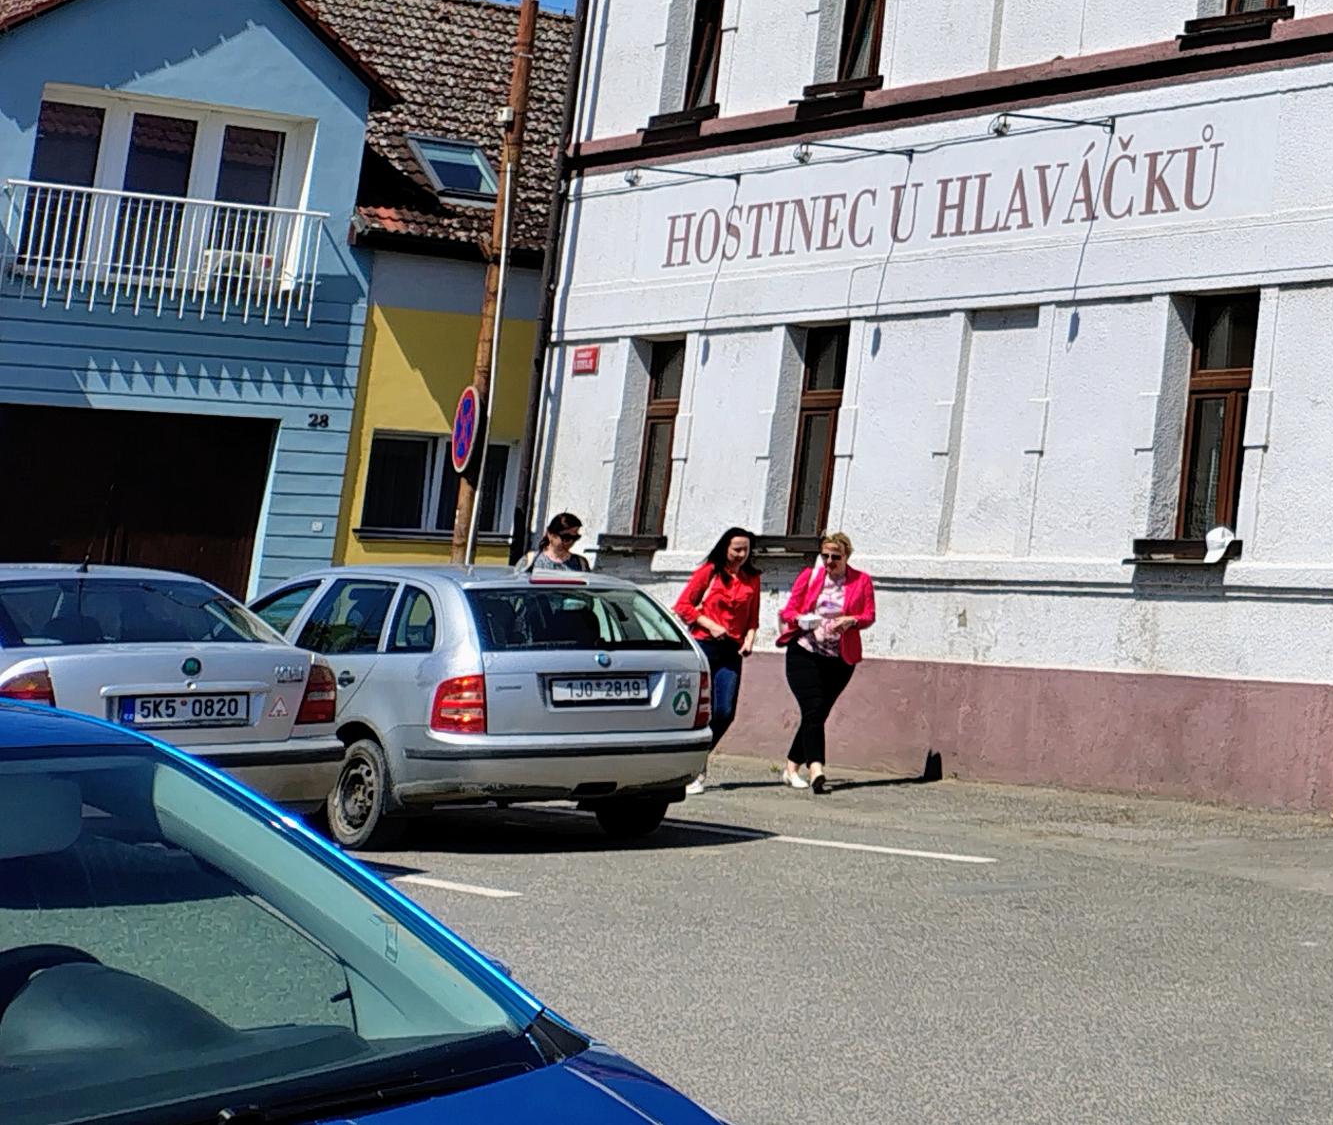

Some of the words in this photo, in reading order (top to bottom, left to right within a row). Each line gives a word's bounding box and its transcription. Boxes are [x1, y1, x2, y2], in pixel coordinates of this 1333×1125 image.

[661, 187, 879, 269] HOSTINEC
[888, 182, 924, 245] U
[930, 124, 1225, 240] HLAVÁČKŮ
[307, 413, 329, 428] 28
[566, 681, 593, 698] 1J0
[604, 680, 641, 697] 2819
[139, 699, 177, 719] 5K5
[191, 698, 239, 717] 0820
